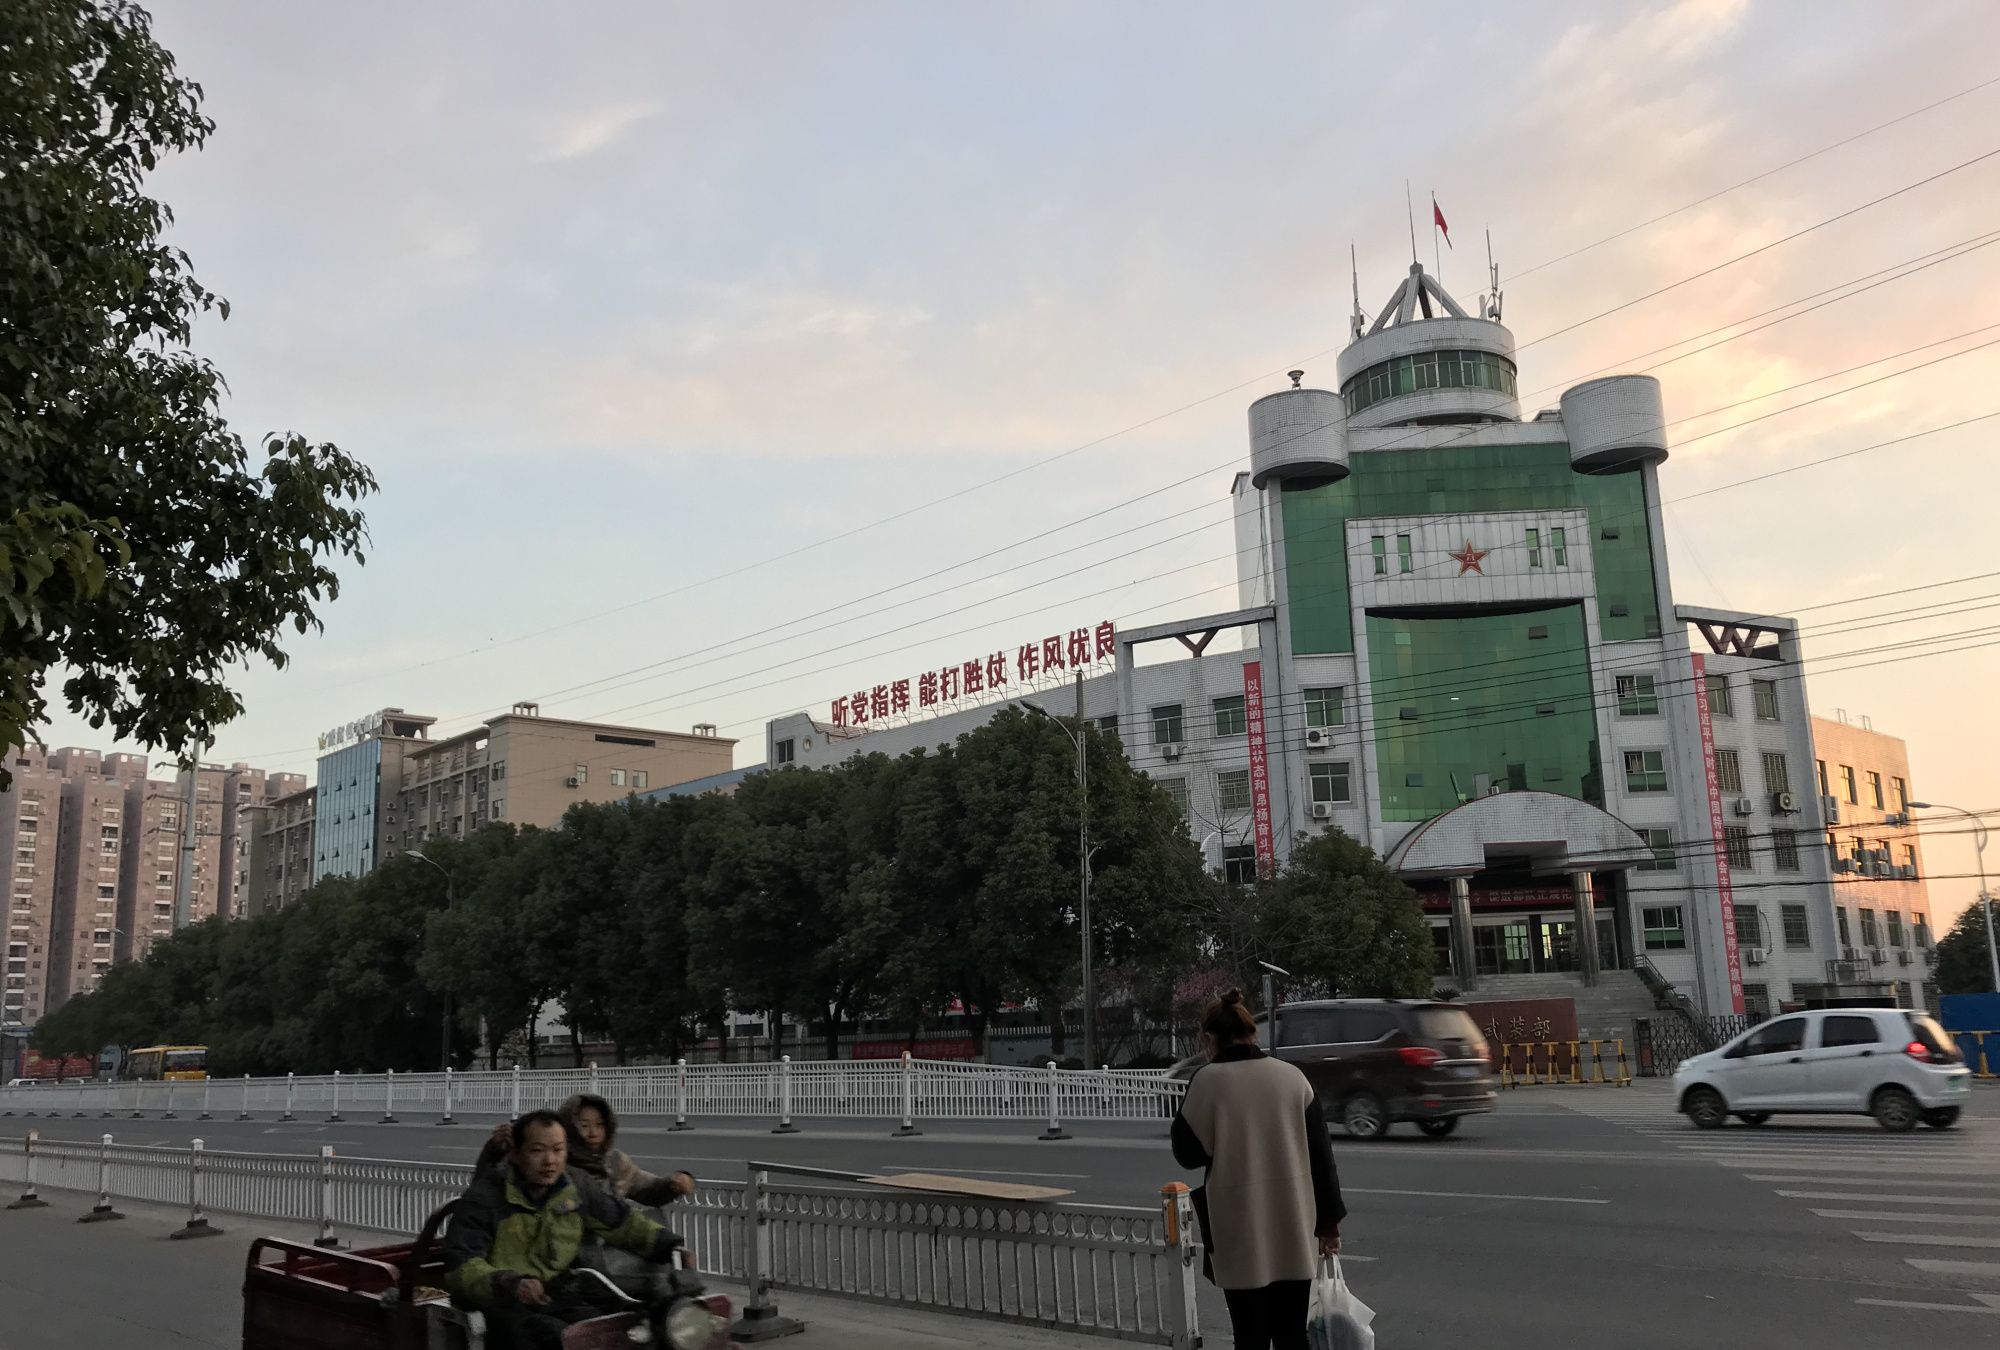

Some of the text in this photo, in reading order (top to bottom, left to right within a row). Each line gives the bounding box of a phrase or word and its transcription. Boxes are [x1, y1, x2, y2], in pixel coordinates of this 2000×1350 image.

[831, 620, 1116, 727] 听党指挥 能打胜仗 作风优良
[1695, 669, 1743, 997] 高举习近平新时代中国特色社会主义思想伟大旗帜
[1483, 1015, 1551, 1042] 武装部
